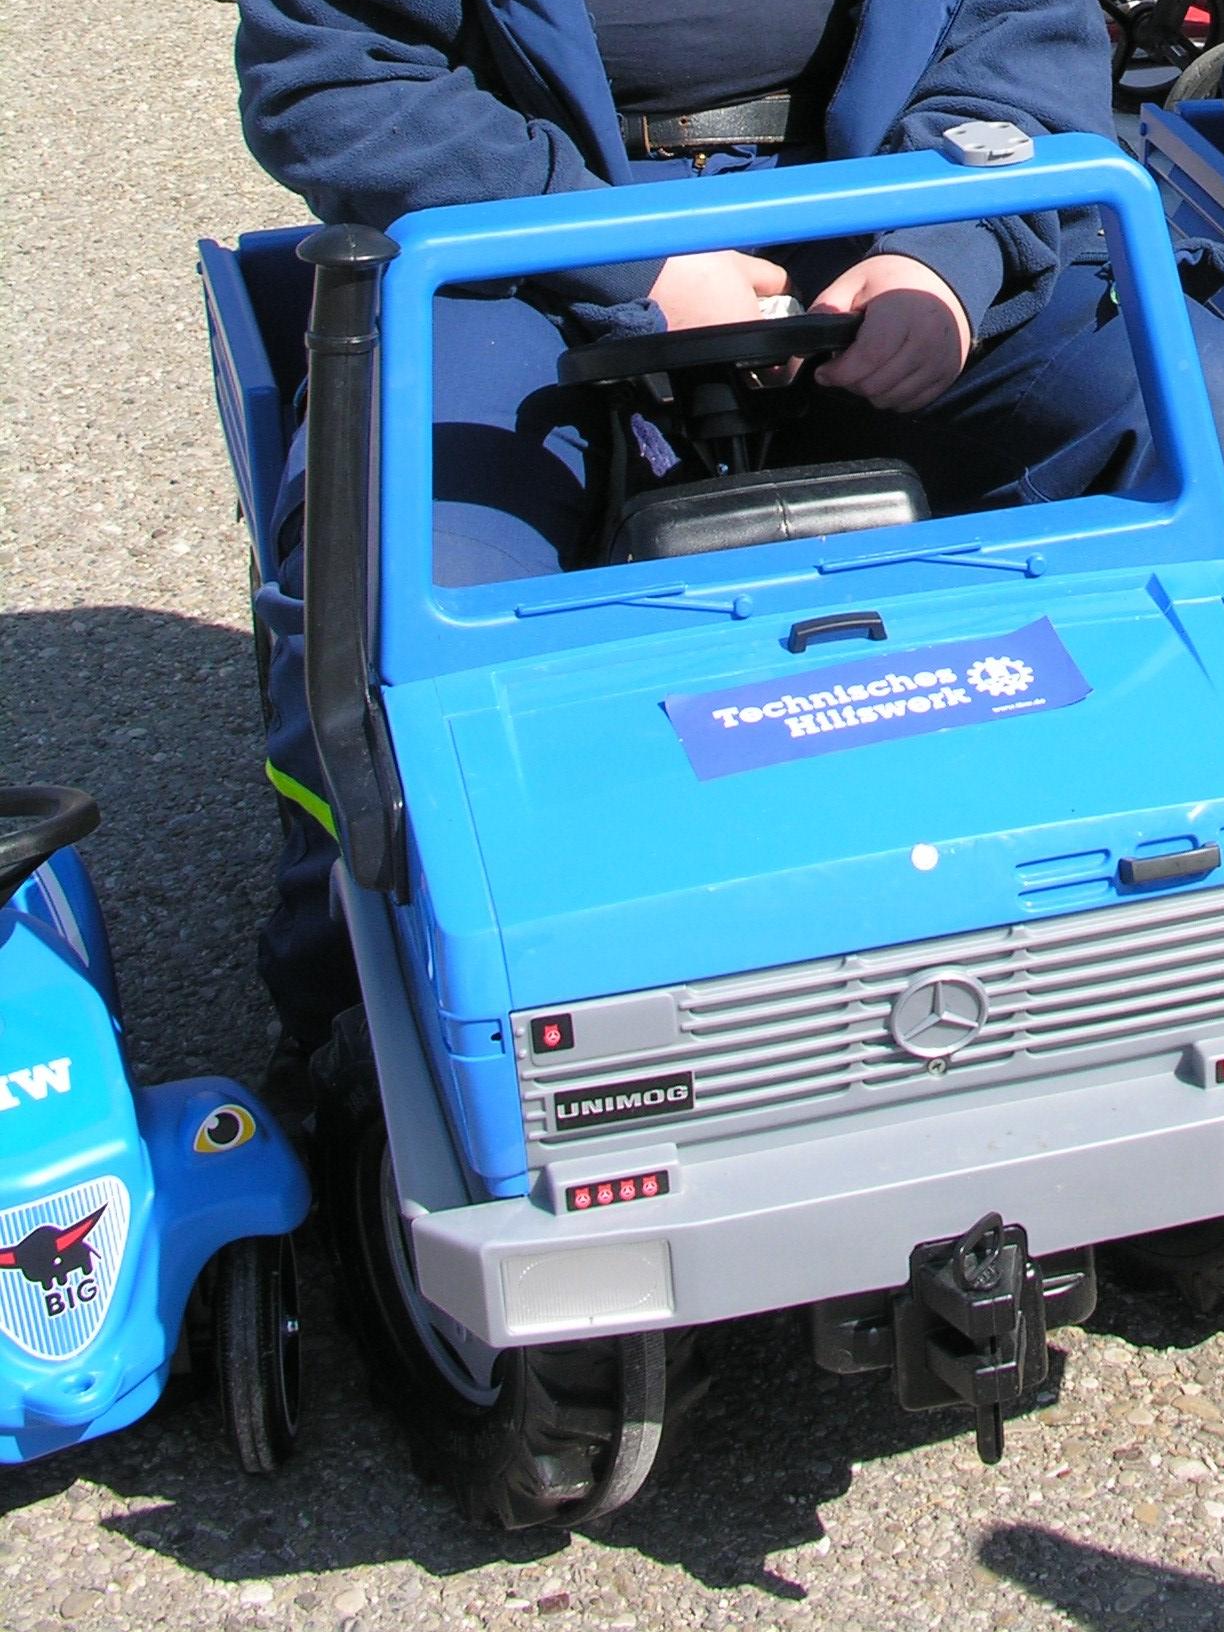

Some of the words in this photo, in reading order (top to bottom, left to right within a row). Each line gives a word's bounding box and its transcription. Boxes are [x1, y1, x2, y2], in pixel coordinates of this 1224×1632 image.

[712, 668, 957, 728] Technisches
[784, 686, 971, 738] Hilfswerk
[557, 1085, 689, 1119] UNIMOG
[44, 1278, 97, 1317] BIG
